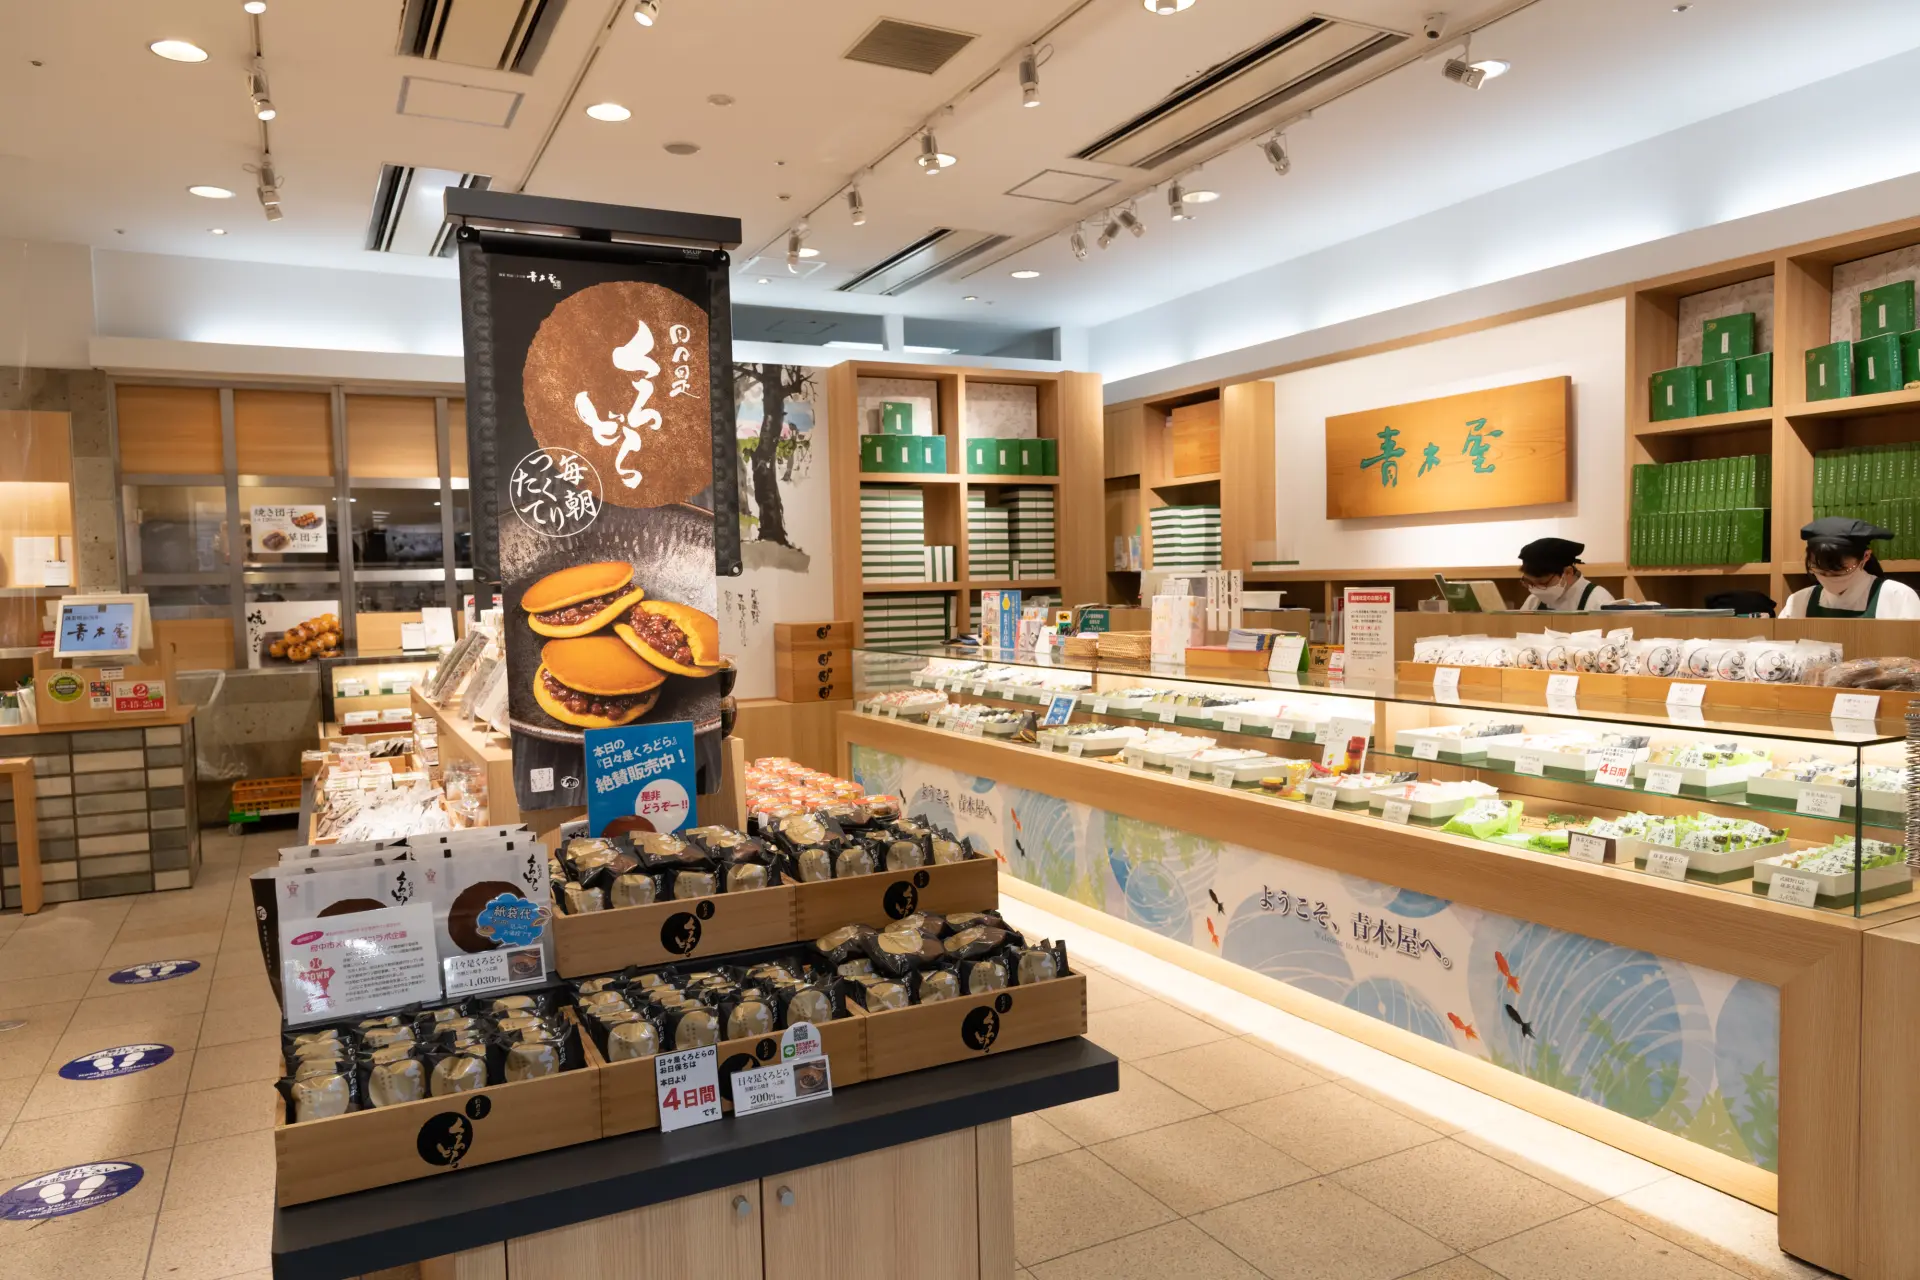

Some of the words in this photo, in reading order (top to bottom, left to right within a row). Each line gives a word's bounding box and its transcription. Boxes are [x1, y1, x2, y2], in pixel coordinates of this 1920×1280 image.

[1360, 417, 1504, 488] 青木屋
[254, 507, 297, 517] 焼き団子
[67, 622, 129, 642] 青木屋
[593, 738, 625, 758] 本日の
[1599, 763, 1627, 777] 4日間
[641, 790, 661, 803] 是非
[494, 905, 532, 920] 紙袋代
[1260, 884, 1453, 970] ようこそ、青木屋へ。
[304, 970, 330, 980] TOWN
[659, 1049, 715, 1067] 日々是くろどらの
[659, 1061, 697, 1075] お日保ちは
[660, 1074, 687, 1087] 本日より
[738, 1068, 790, 1087] 日々是くろどら
[662, 1084, 716, 1111] 4日間
[749, 1092, 776, 1105] 200円
[702, 1107, 719, 1116] です。
[17, 1206, 46, 1215] Keep
[74, 1191, 119, 1203] distance
